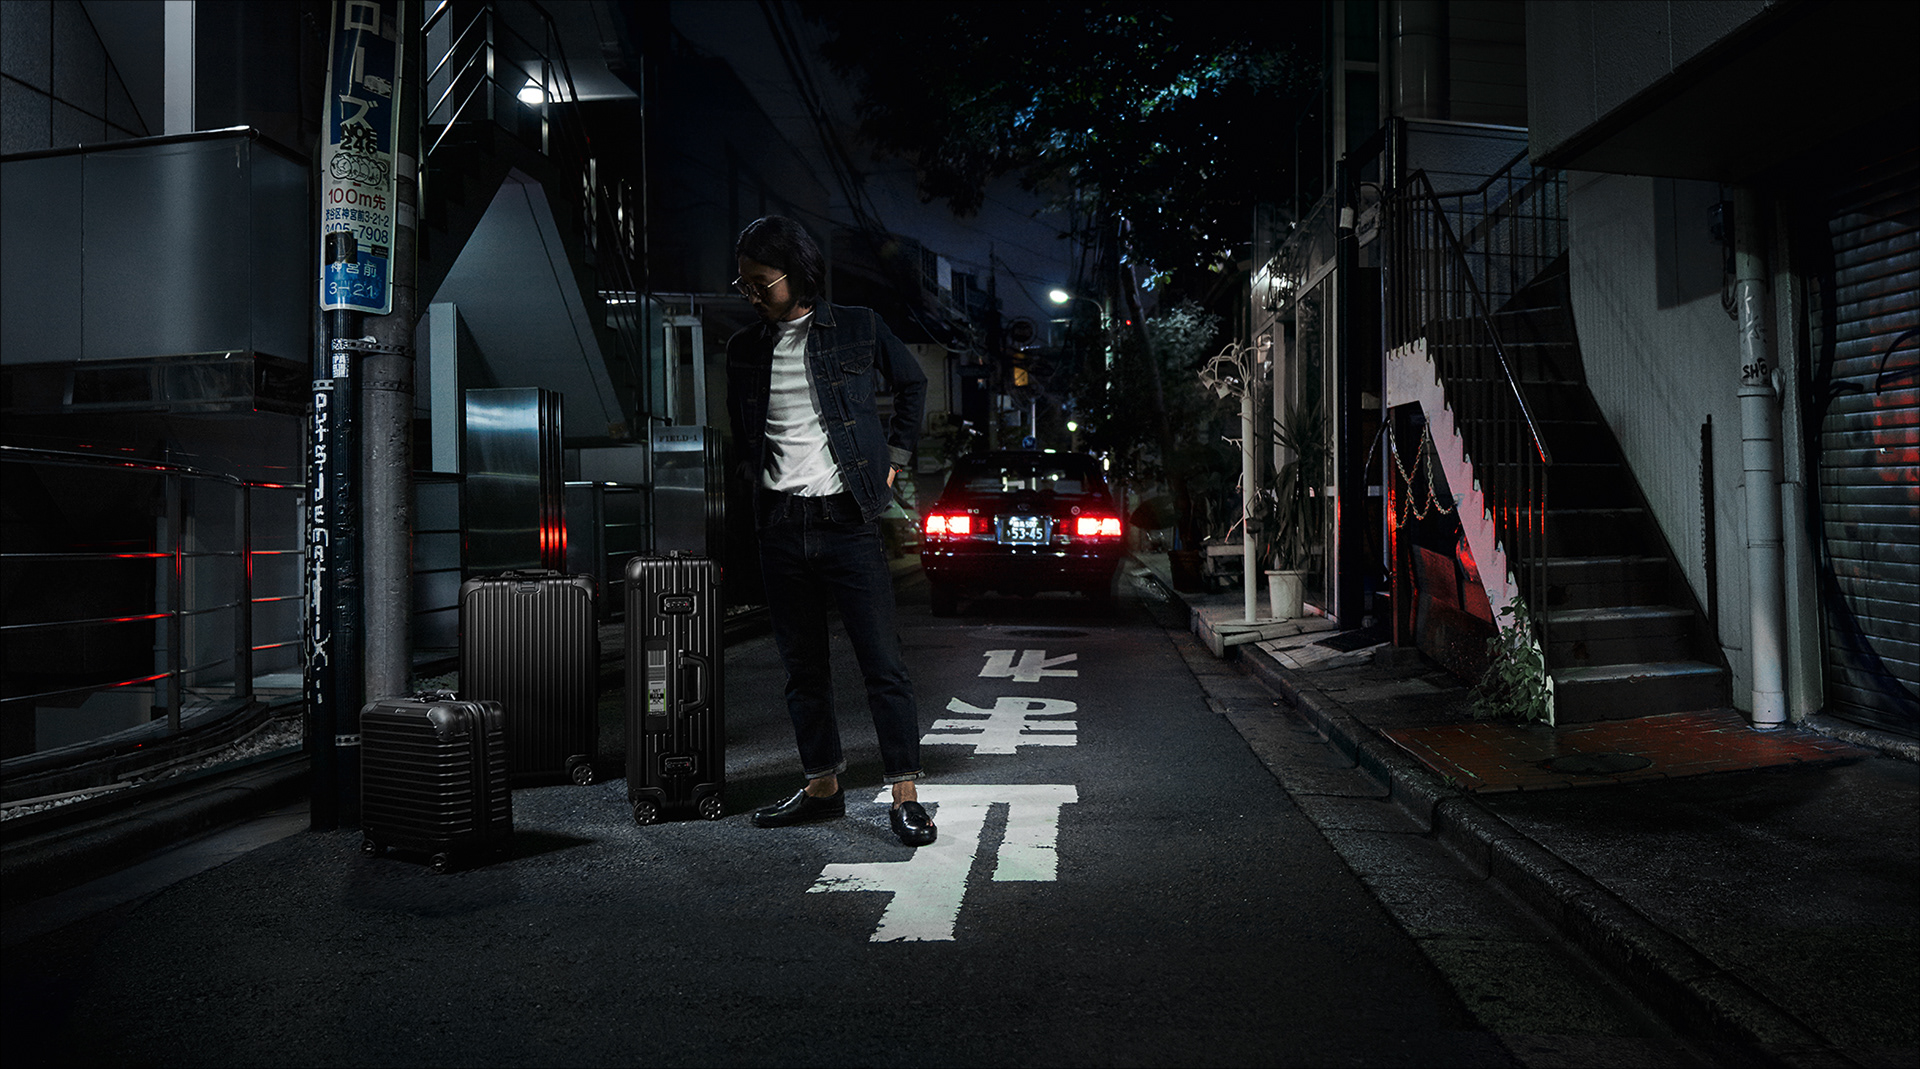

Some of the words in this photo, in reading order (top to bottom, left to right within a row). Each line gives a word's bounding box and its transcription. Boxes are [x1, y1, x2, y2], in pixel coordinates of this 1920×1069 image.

[339, 136, 378, 155] 246
[328, 188, 386, 211] 100m先
[330, 260, 377, 278] 神宮前
[659, 434, 698, 442] FIELD-1
